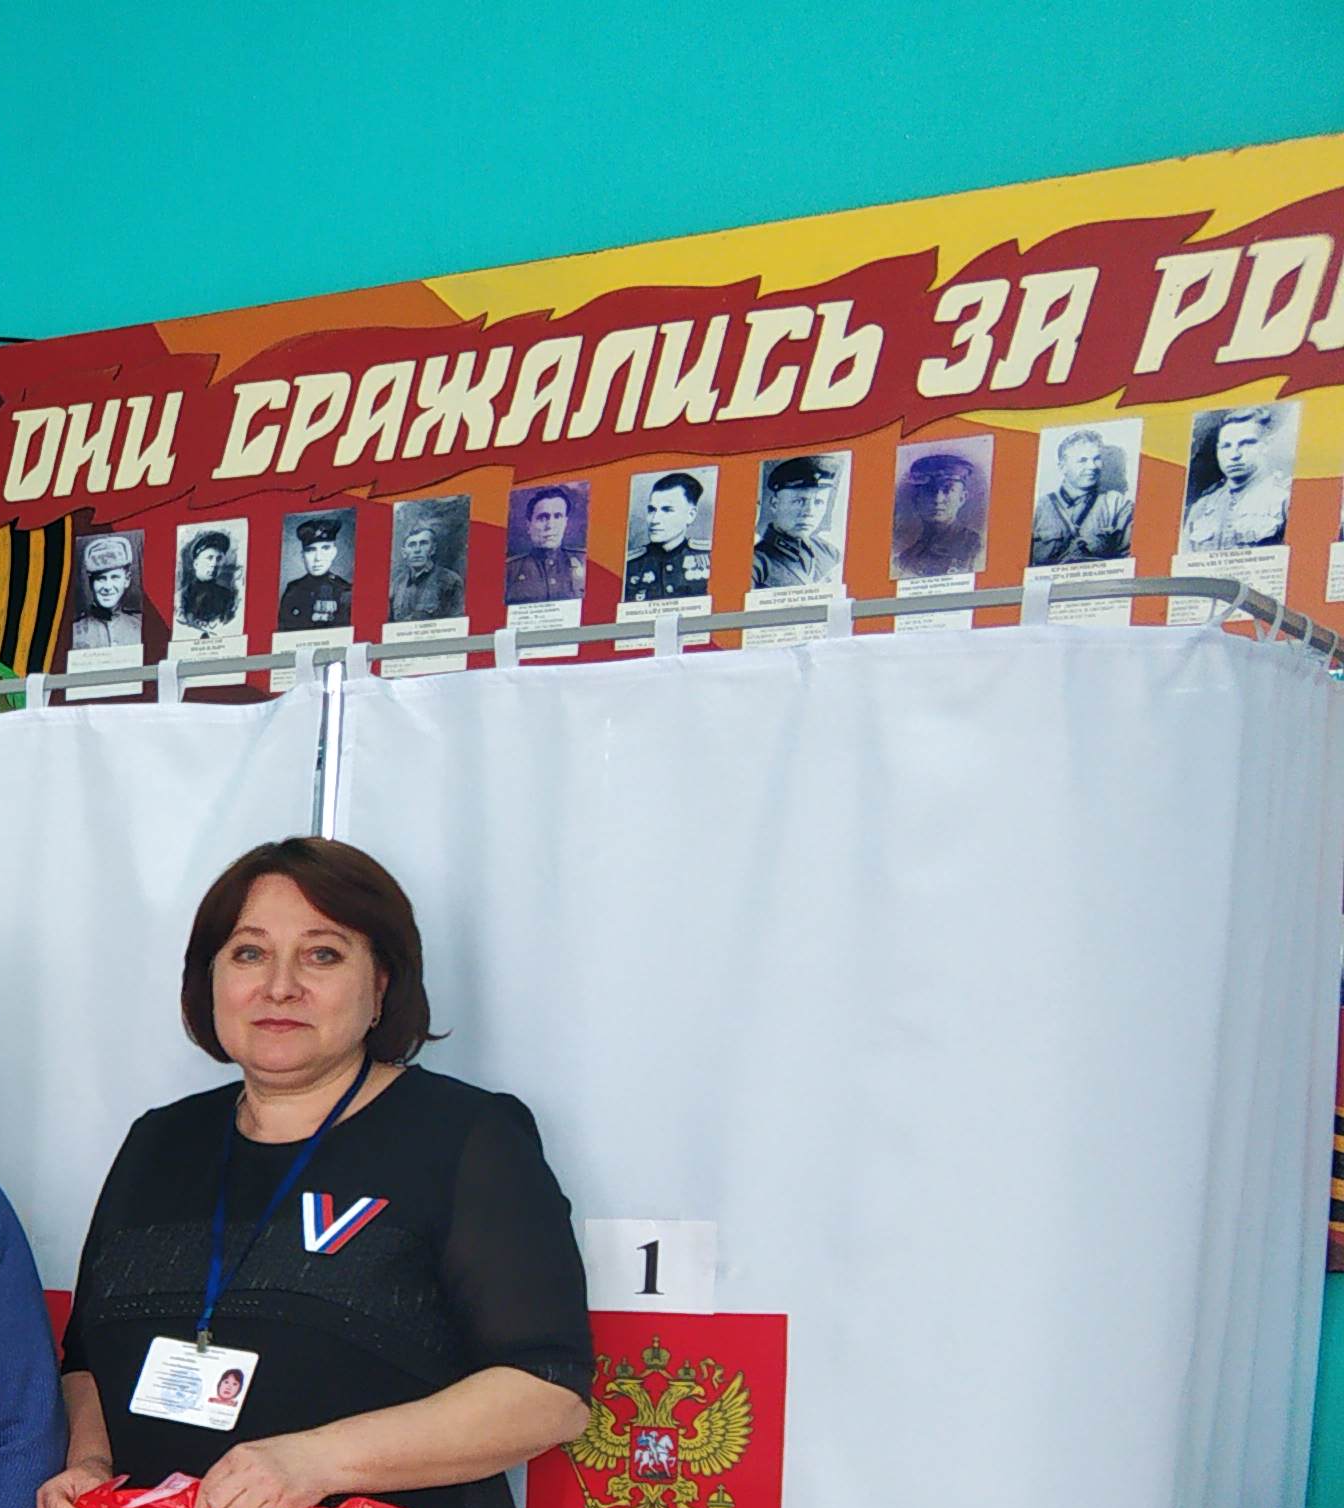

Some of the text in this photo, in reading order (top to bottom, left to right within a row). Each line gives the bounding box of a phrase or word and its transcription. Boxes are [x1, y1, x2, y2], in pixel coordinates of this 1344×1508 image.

[3, 390, 184, 501] ОНИ
[213, 299, 884, 480] СРАЖАЛИСЬ
[916, 266, 1100, 398] ЗА
[633, 1239, 665, 1296] 1
